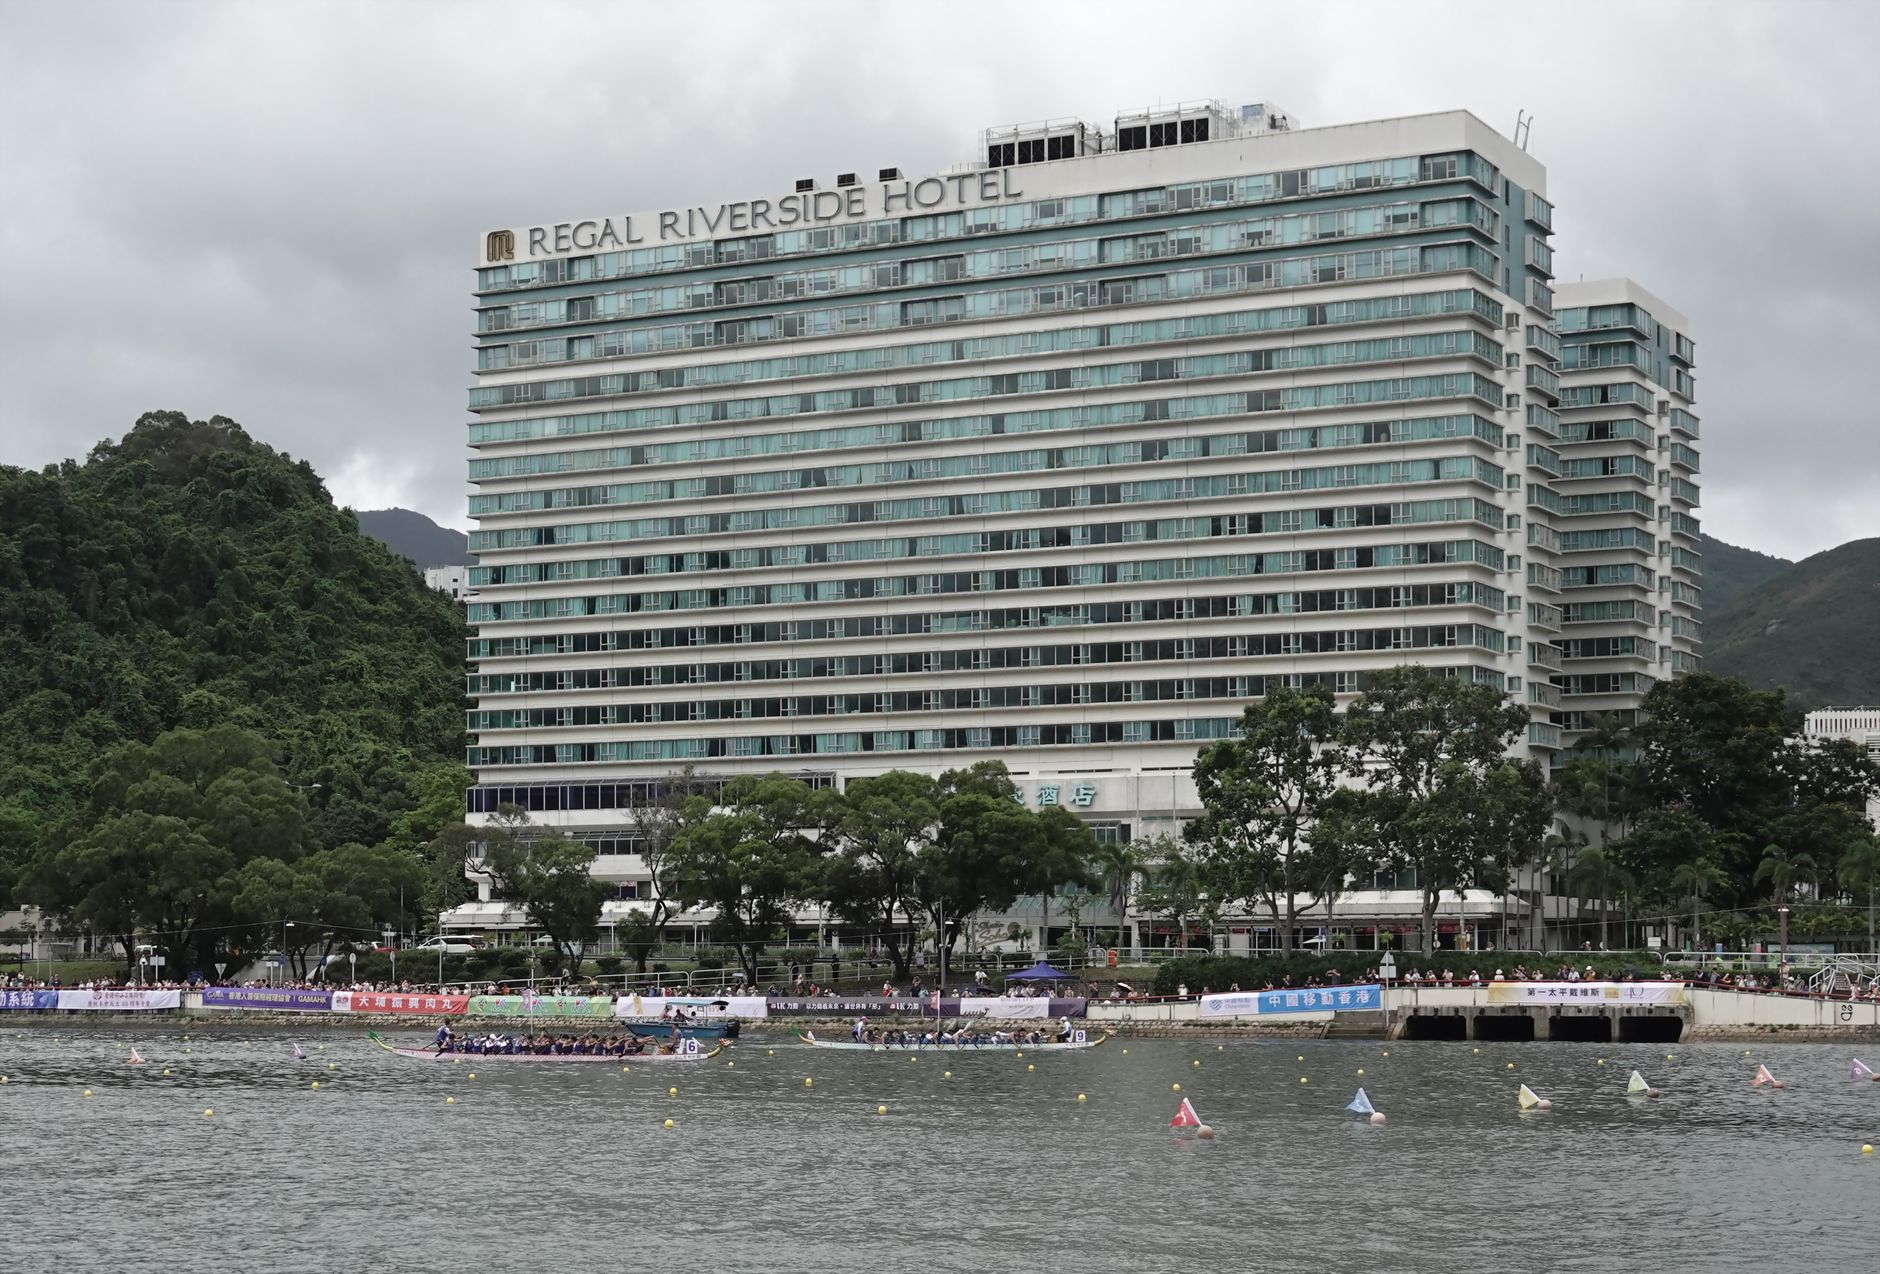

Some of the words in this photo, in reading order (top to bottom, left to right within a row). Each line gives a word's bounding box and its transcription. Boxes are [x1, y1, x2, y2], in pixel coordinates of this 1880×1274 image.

[528, 215, 644, 256] REGAL
[659, 187, 866, 240] RIVERSIDE
[884, 168, 1024, 213] HOTEL
[358, 996, 453, 1009] 大埔振興肉丸
[1268, 990, 1370, 1008] 中國移動香港
[1077, 1031, 1084, 1041] 9
[688, 1041, 696, 1052] 6
